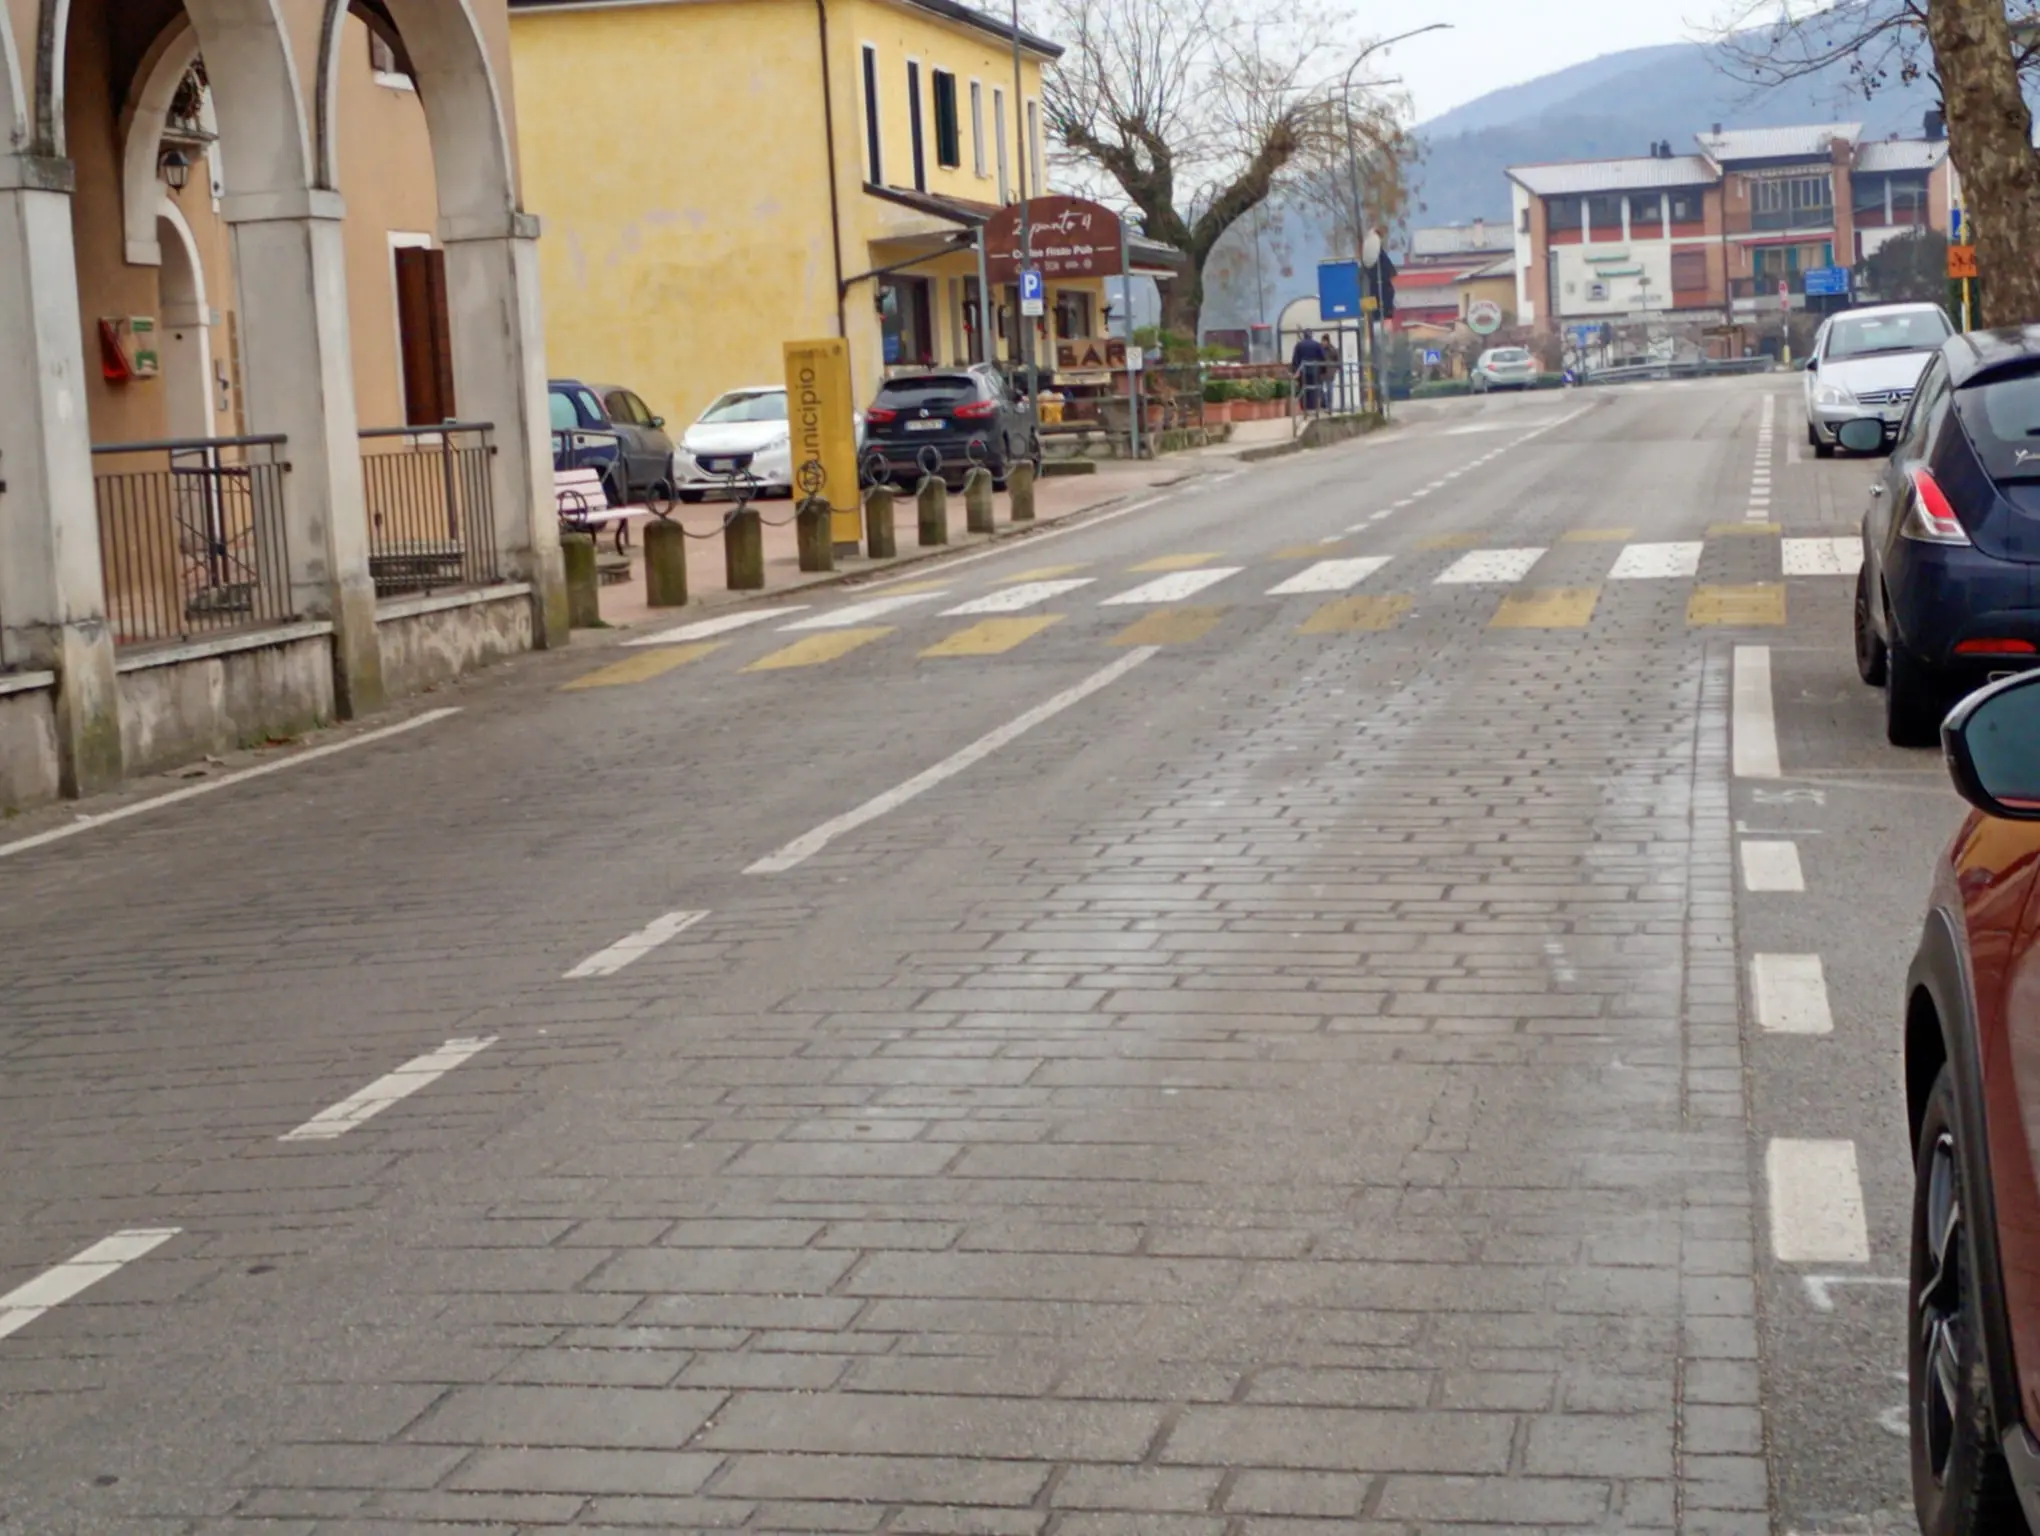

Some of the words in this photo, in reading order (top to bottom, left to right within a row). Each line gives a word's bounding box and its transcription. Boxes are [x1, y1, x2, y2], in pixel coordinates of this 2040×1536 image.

[1012, 248, 1044, 259] Cfee
[1023, 273, 1038, 298] P
[1057, 343, 1126, 367] BAR
